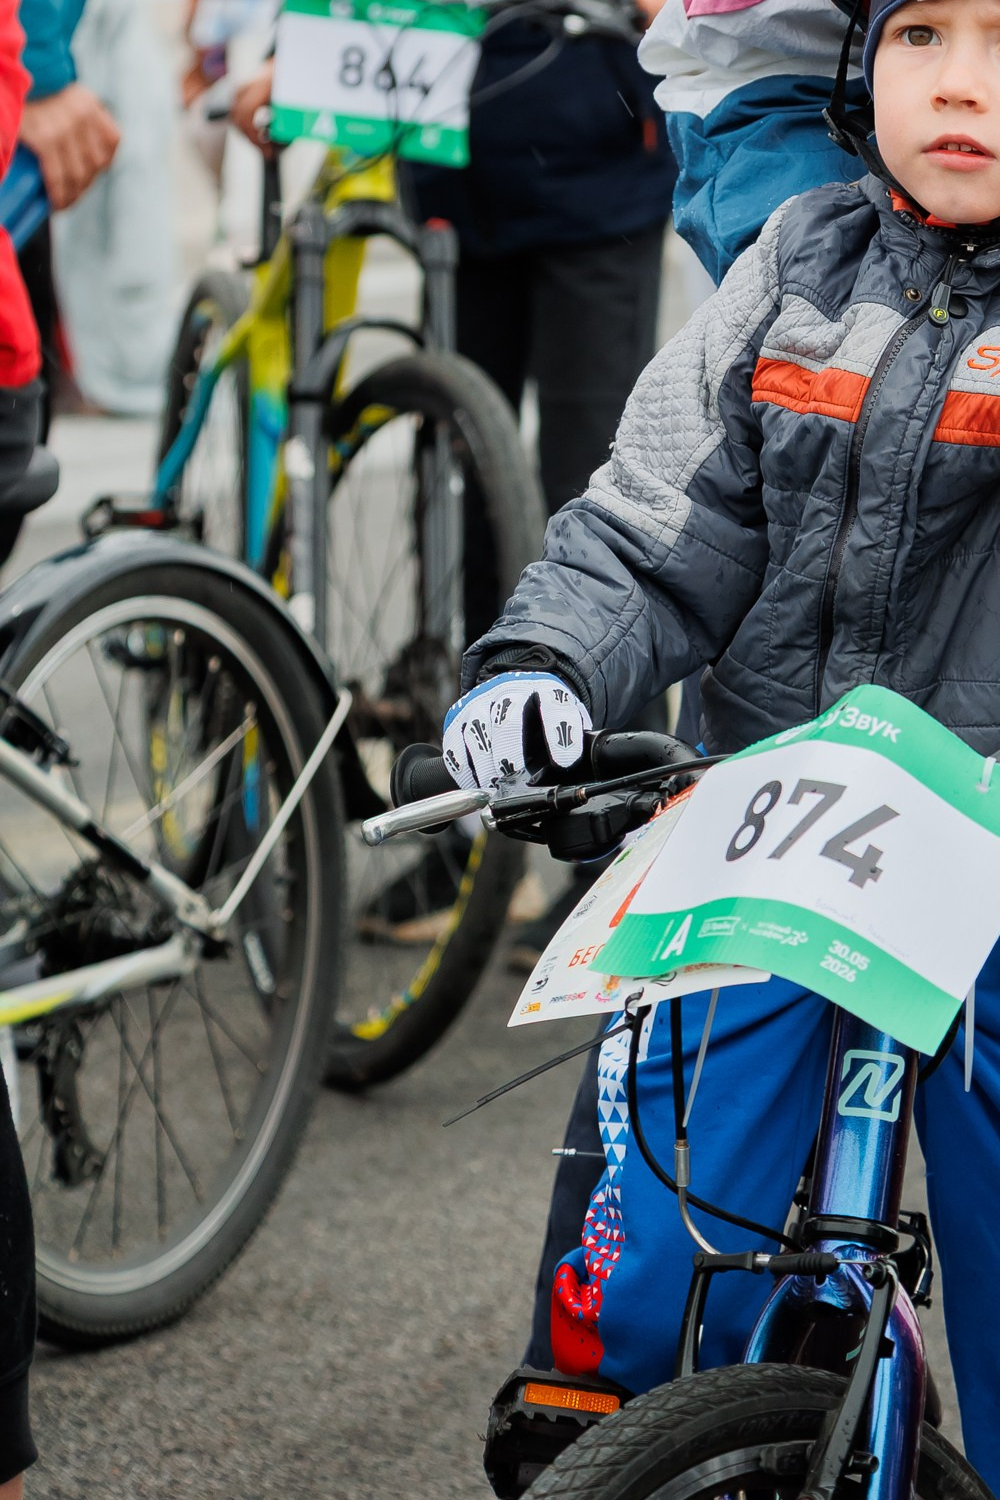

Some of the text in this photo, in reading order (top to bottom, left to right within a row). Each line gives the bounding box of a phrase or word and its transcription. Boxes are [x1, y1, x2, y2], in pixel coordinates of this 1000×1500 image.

[339, 46, 431, 97] 864
[839, 706, 902, 743] Звук
[725, 778, 901, 889] 874
[819, 954, 857, 983] 2026
[827, 939, 871, 971] 30.05
